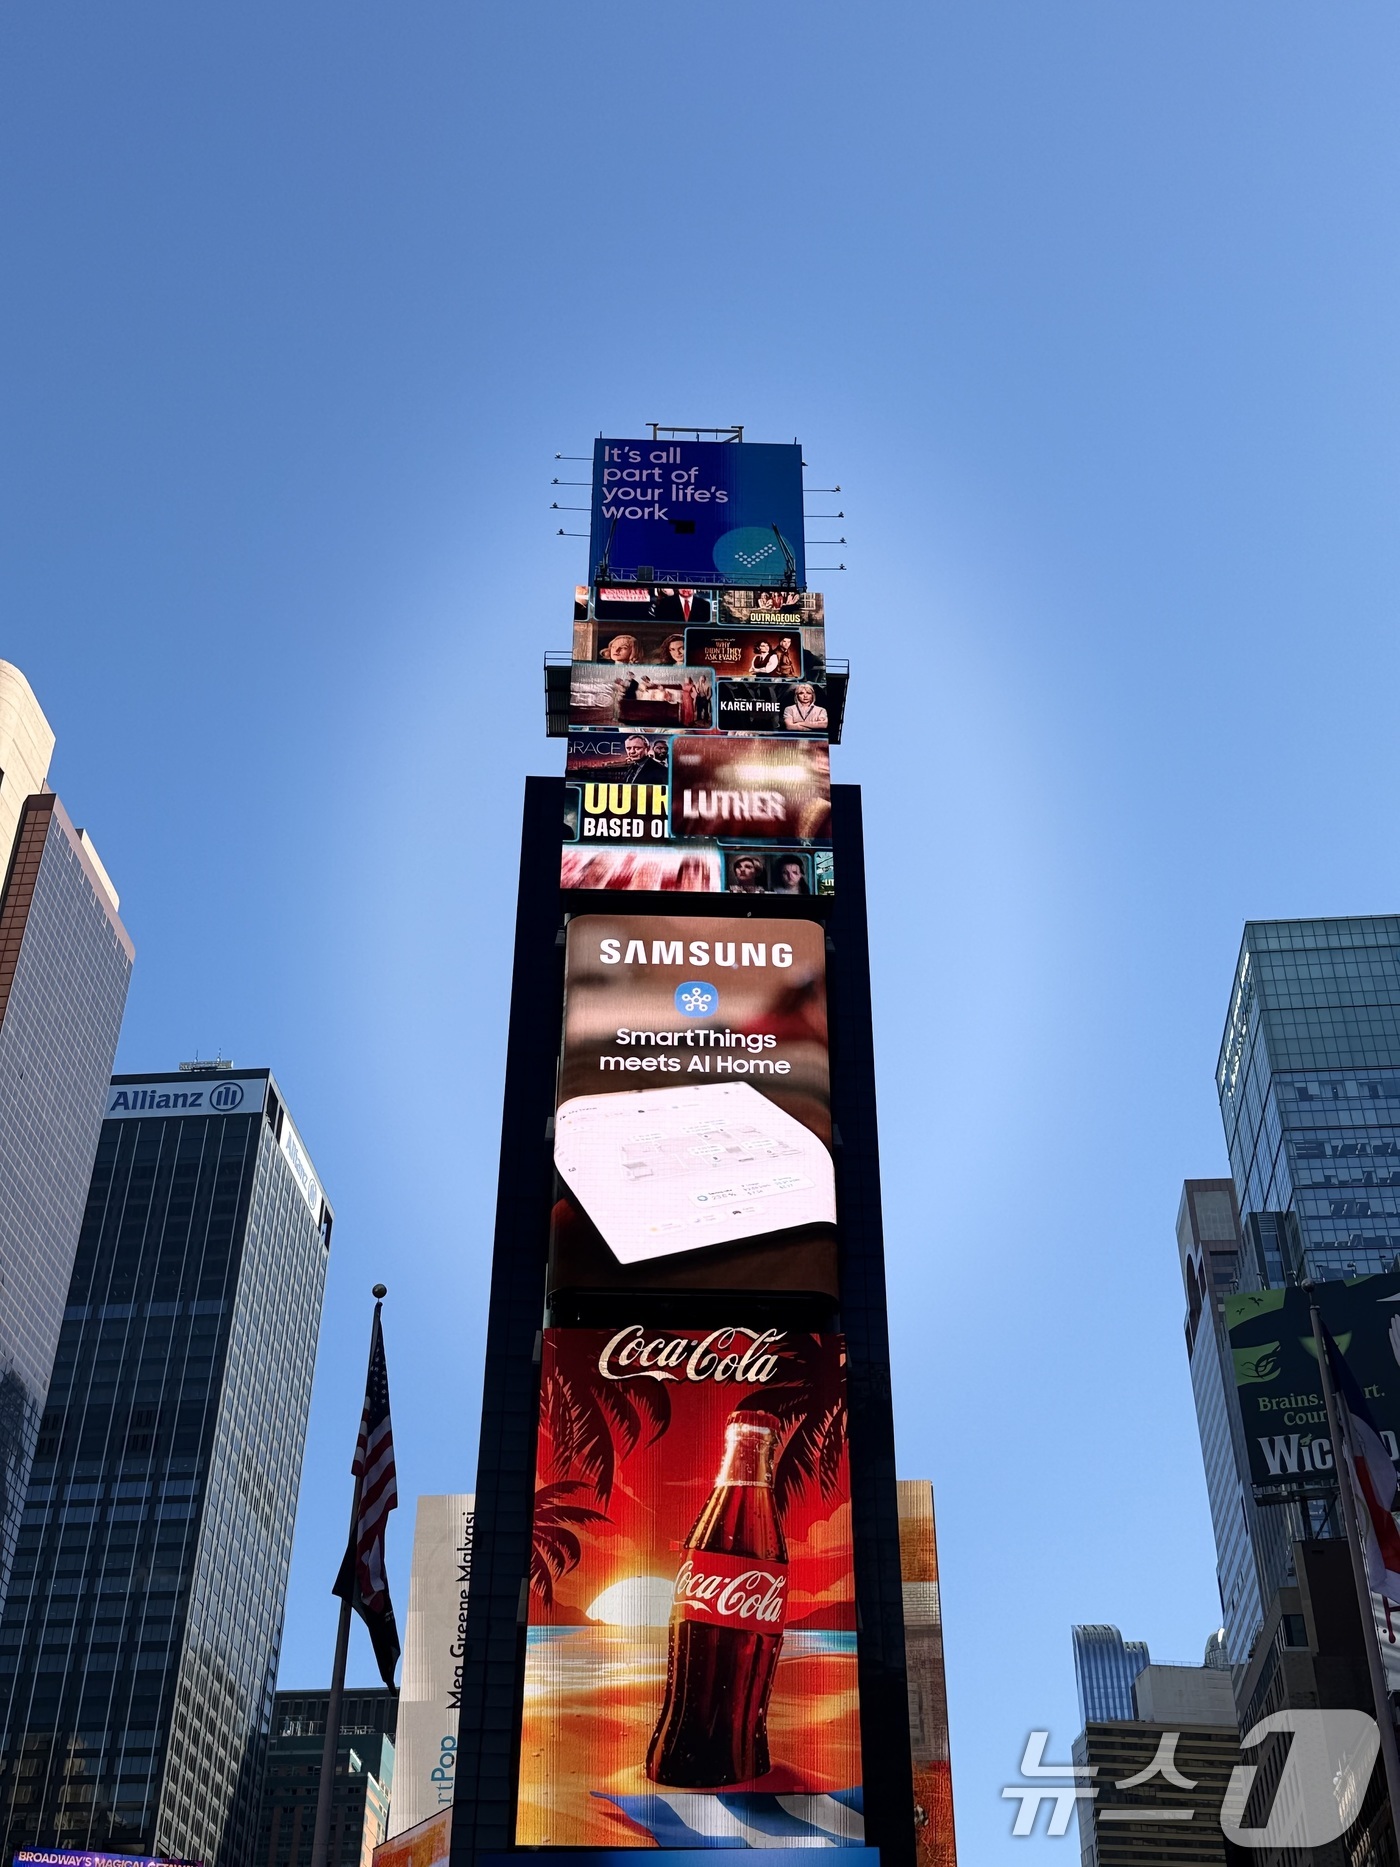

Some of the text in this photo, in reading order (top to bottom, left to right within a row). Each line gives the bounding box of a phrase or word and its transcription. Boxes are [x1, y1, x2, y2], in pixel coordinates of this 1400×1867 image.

[603, 445, 681, 464] It's all
[603, 466, 699, 485] part of
[602, 484, 729, 504] your life's
[601, 503, 669, 520] work
[750, 612, 801, 623] OUTRAGEOUS
[720, 700, 781, 712] KAREN PIRIE
[683, 788, 787, 822] LUTHER
[583, 817, 644, 837] BASED
[599, 938, 794, 967] SAMSUNG
[615, 1027, 777, 1054] SmartThings
[599, 1054, 792, 1075] meets AI Home
[110, 1089, 204, 1112] Allianz
[1257, 1392, 1324, 1412] Brains.
[450, 1589, 470, 1658] Greene
[17, 1850, 92, 1867] BROADWAY'S
